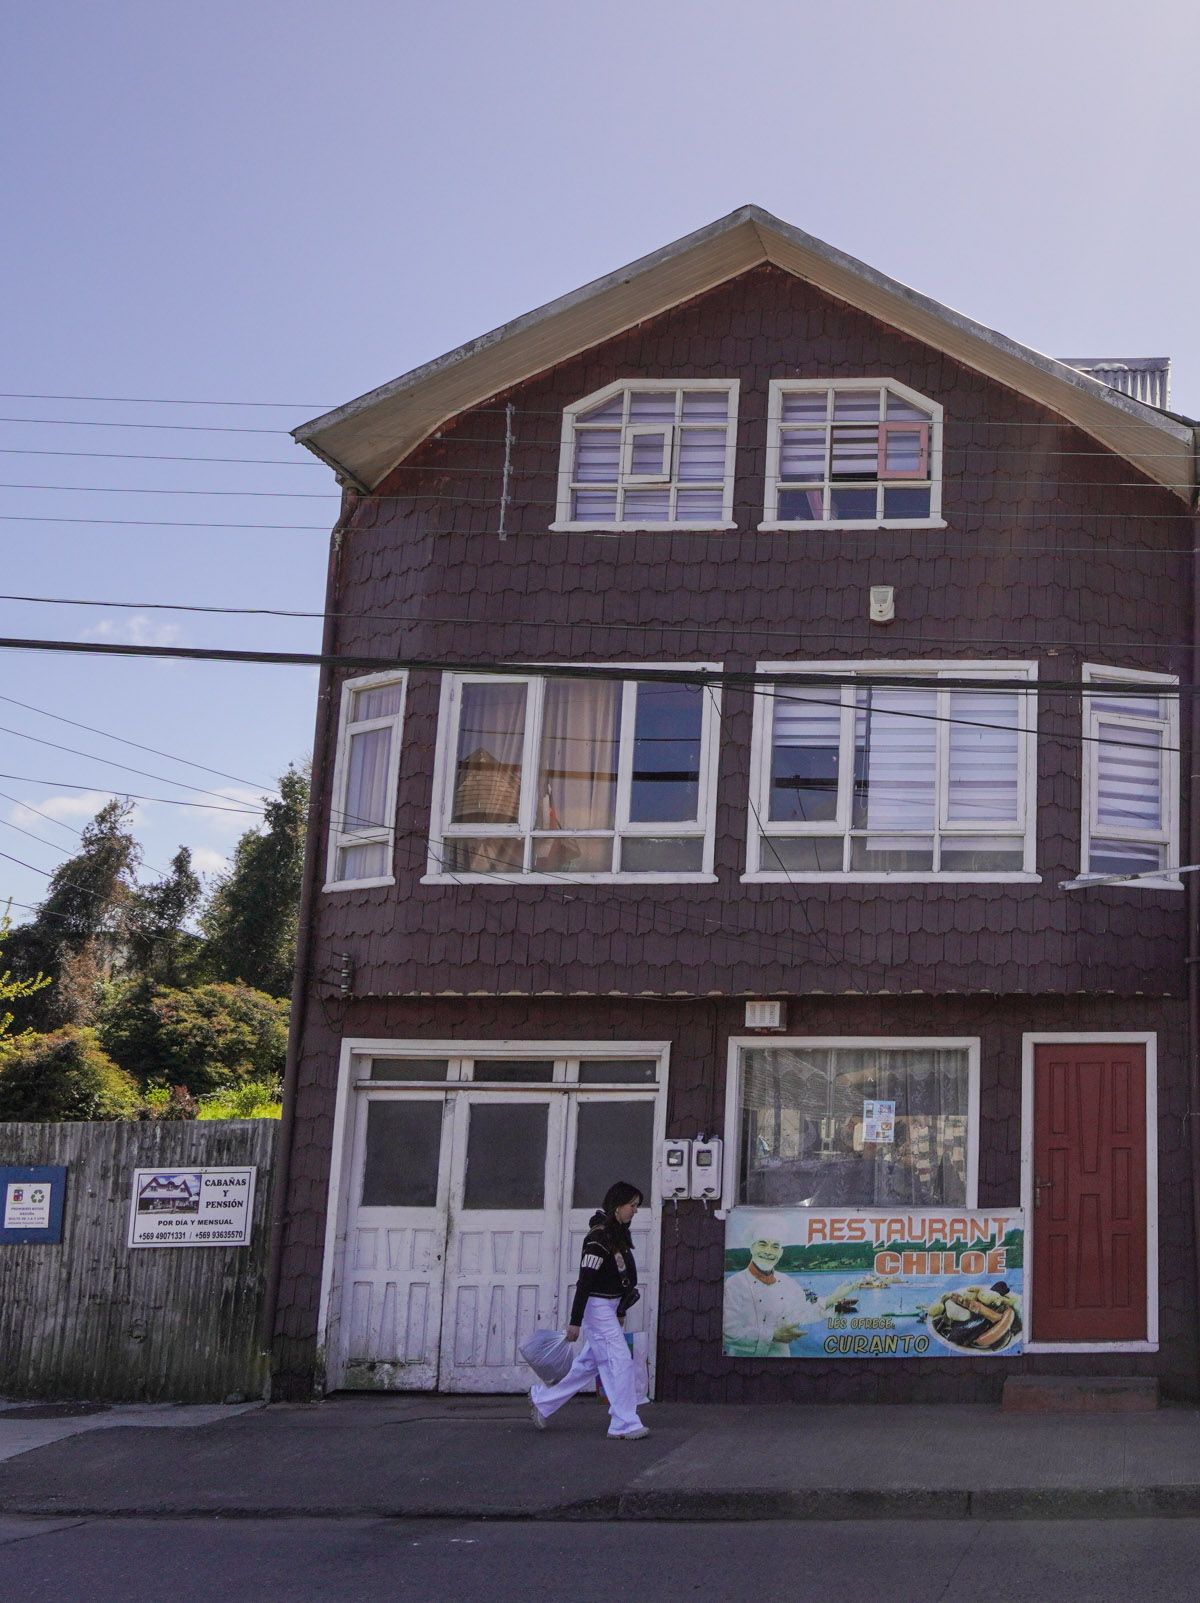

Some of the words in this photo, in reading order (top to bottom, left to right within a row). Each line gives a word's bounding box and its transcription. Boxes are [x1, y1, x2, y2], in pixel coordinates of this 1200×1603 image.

[204, 1177, 247, 1187] CABAÑAS
[205, 1199, 244, 1209] PENSIÓN
[138, 1232, 154, 1240] +569
[155, 1232, 186, 1240] 49071331
[195, 1231, 211, 1239] +569
[211, 1231, 243, 1239] 93635570
[806, 1215, 1010, 1248] RESTAURANT
[874, 1246, 1009, 1275] CHILOÉ
[828, 1317, 848, 1329] LES
[824, 1335, 930, 1354] CURANTO
